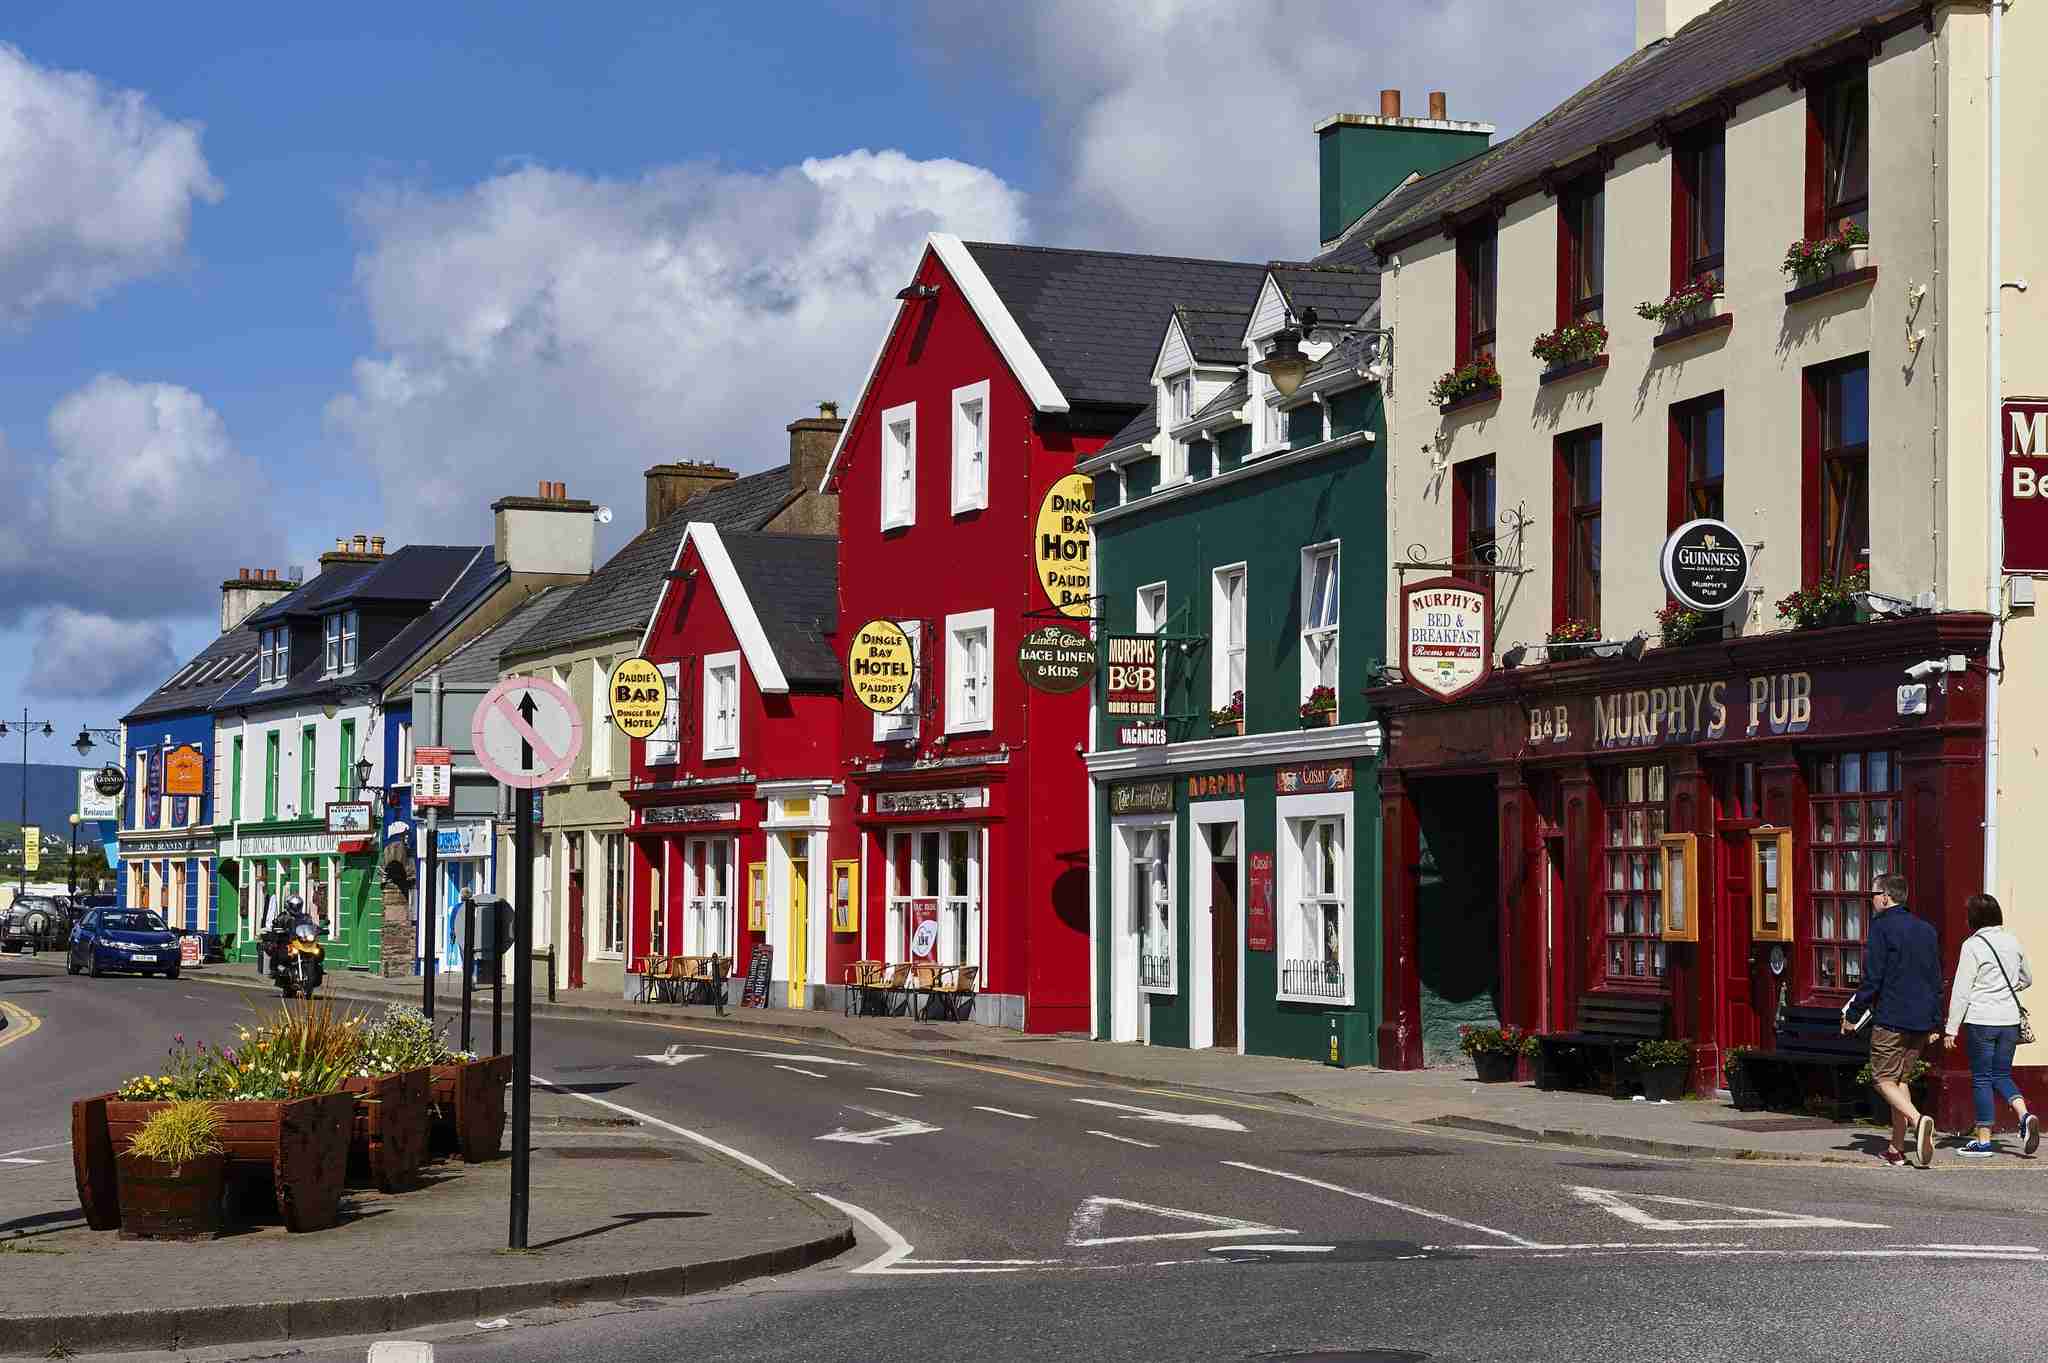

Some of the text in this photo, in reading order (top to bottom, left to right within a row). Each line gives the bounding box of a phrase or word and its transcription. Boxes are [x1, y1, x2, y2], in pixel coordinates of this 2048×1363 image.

[1052, 494, 1096, 514] DING
[1062, 515, 1090, 534] BA
[1041, 533, 1090, 561] HOT
[1679, 548, 1741, 567] GUINNESS
[1047, 570, 1090, 588] PAUDI
[1412, 593, 1482, 614] MURPHY'S
[1427, 613, 1464, 628] BED &
[861, 633, 902, 645] DINGLE
[1411, 628, 1481, 644] BREAKFAST
[869, 647, 893, 657] BAY
[1021, 648, 1095, 663] LACE LINEN
[1109, 638, 1156, 664] MURPHYS
[854, 658, 909, 675] HOTEL
[618, 672, 657, 682] PAUDIE'S
[1108, 665, 1156, 691] B&B
[615, 685, 660, 703] BAR
[860, 682, 904, 692] PAUDIE'S
[870, 694, 893, 703] BAR
[1593, 680, 1727, 748] MURPHY'S
[1746, 671, 1812, 737] PUB
[624, 718, 654, 728] HOTEL
[1121, 727, 1167, 745] VACANCIES
